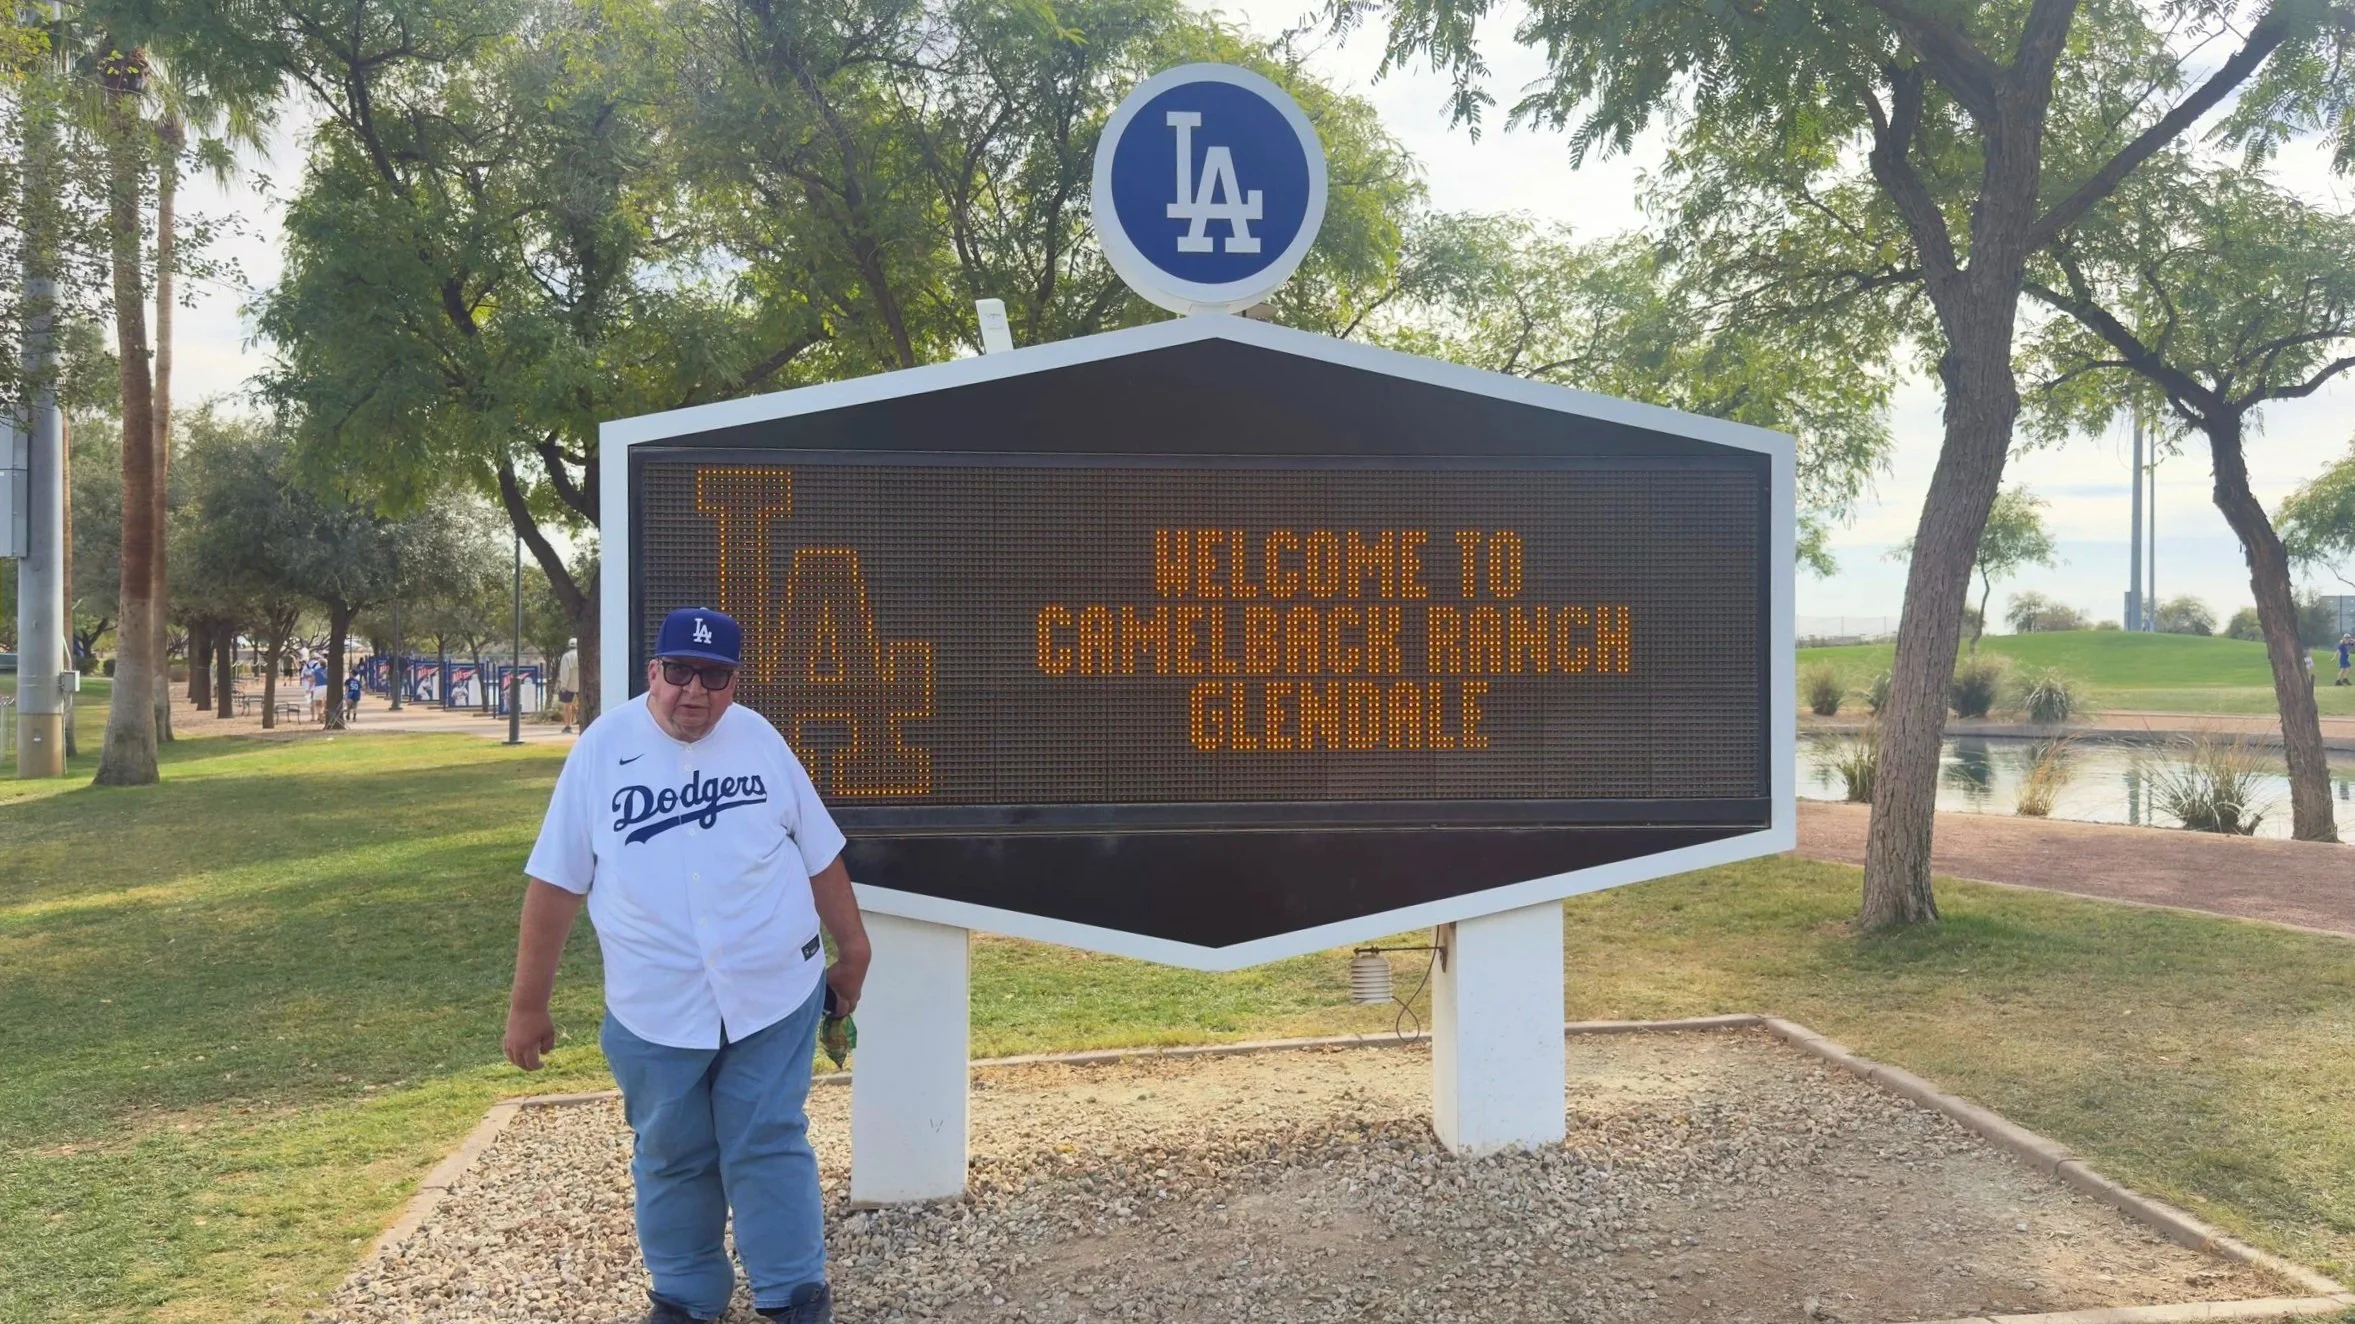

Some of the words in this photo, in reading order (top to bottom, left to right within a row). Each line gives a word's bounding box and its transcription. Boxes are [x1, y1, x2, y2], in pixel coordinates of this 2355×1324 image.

[1166, 111, 1263, 253] LA
[1154, 528, 1428, 600] WELCOME
[1455, 530, 1523, 600] TO
[693, 617, 712, 644] LA
[1036, 604, 1402, 676] CAMELBACK
[1428, 604, 1631, 675] RANCH
[1189, 680, 1490, 751] GLENDALE
[612, 769, 767, 830] Dodgers
